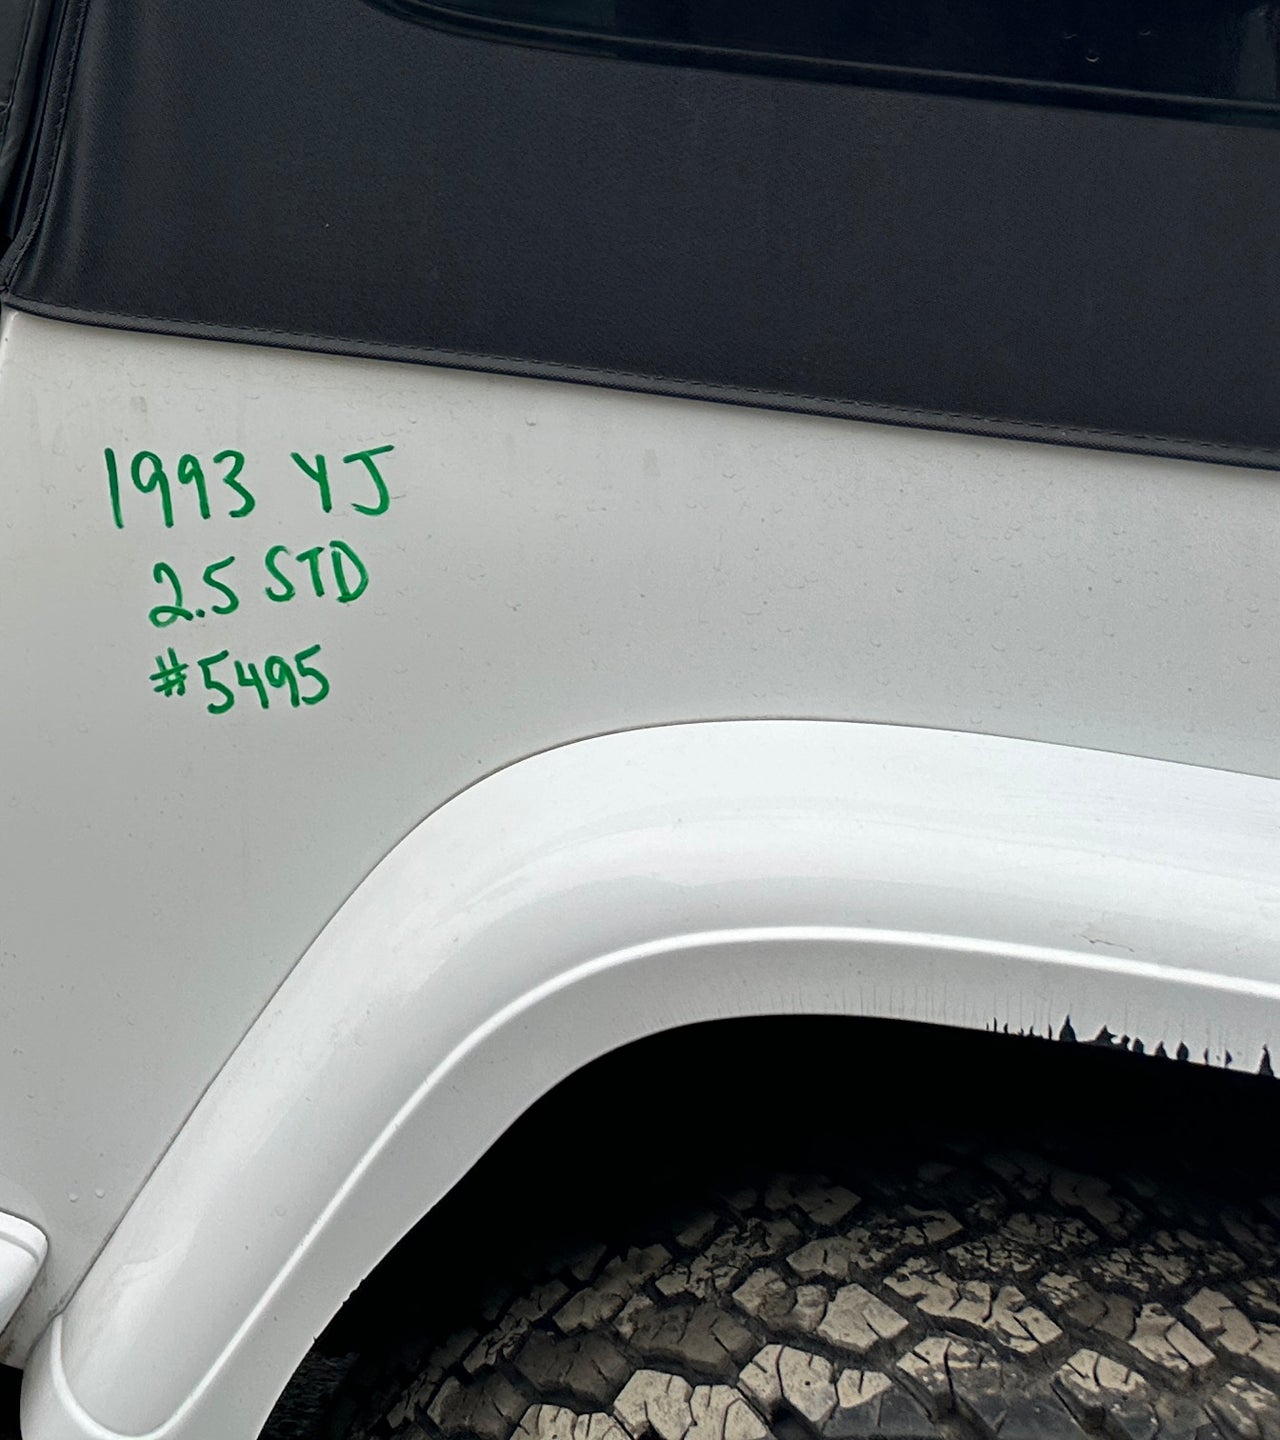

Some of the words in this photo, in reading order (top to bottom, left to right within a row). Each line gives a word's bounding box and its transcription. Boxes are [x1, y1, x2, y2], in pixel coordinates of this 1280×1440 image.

[104, 447, 255, 529] 1993
[290, 445, 394, 516] YJ
[149, 556, 239, 628] 2.5
[264, 540, 370, 603] STD
[149, 644, 330, 714] #5495
